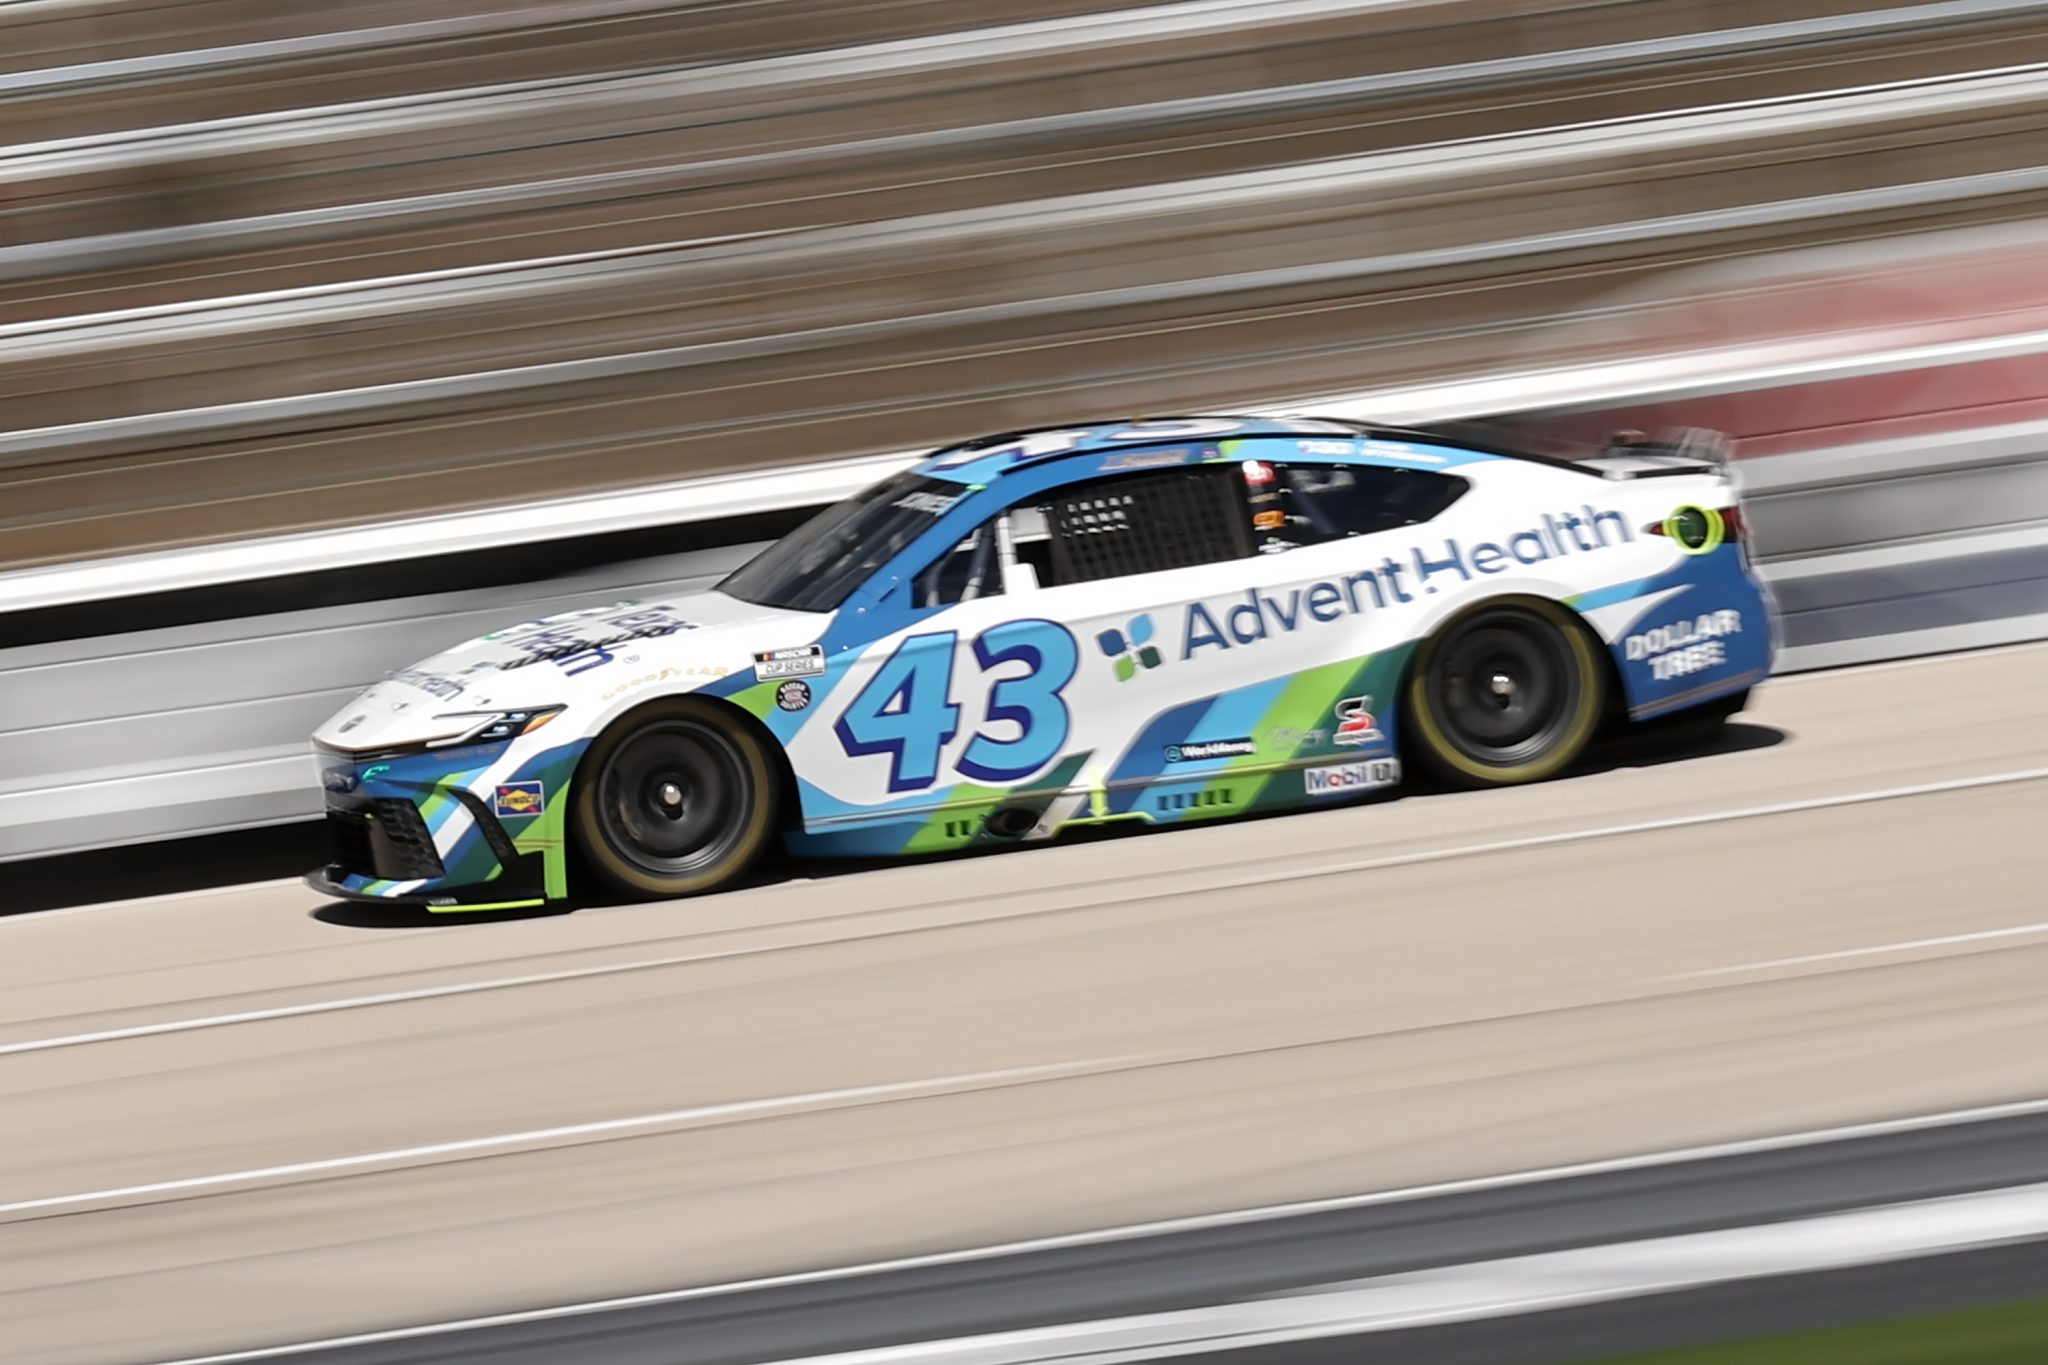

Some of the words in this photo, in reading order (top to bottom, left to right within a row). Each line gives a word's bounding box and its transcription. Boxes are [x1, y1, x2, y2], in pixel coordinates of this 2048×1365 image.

[1625, 608, 1743, 661] DOLLAR
[765, 661, 783, 674] CUP
[784, 658, 815, 673] SERIES
[1647, 640, 1729, 681] TREE
[833, 618, 1079, 794] 43
[1306, 763, 1368, 790] Mobil
